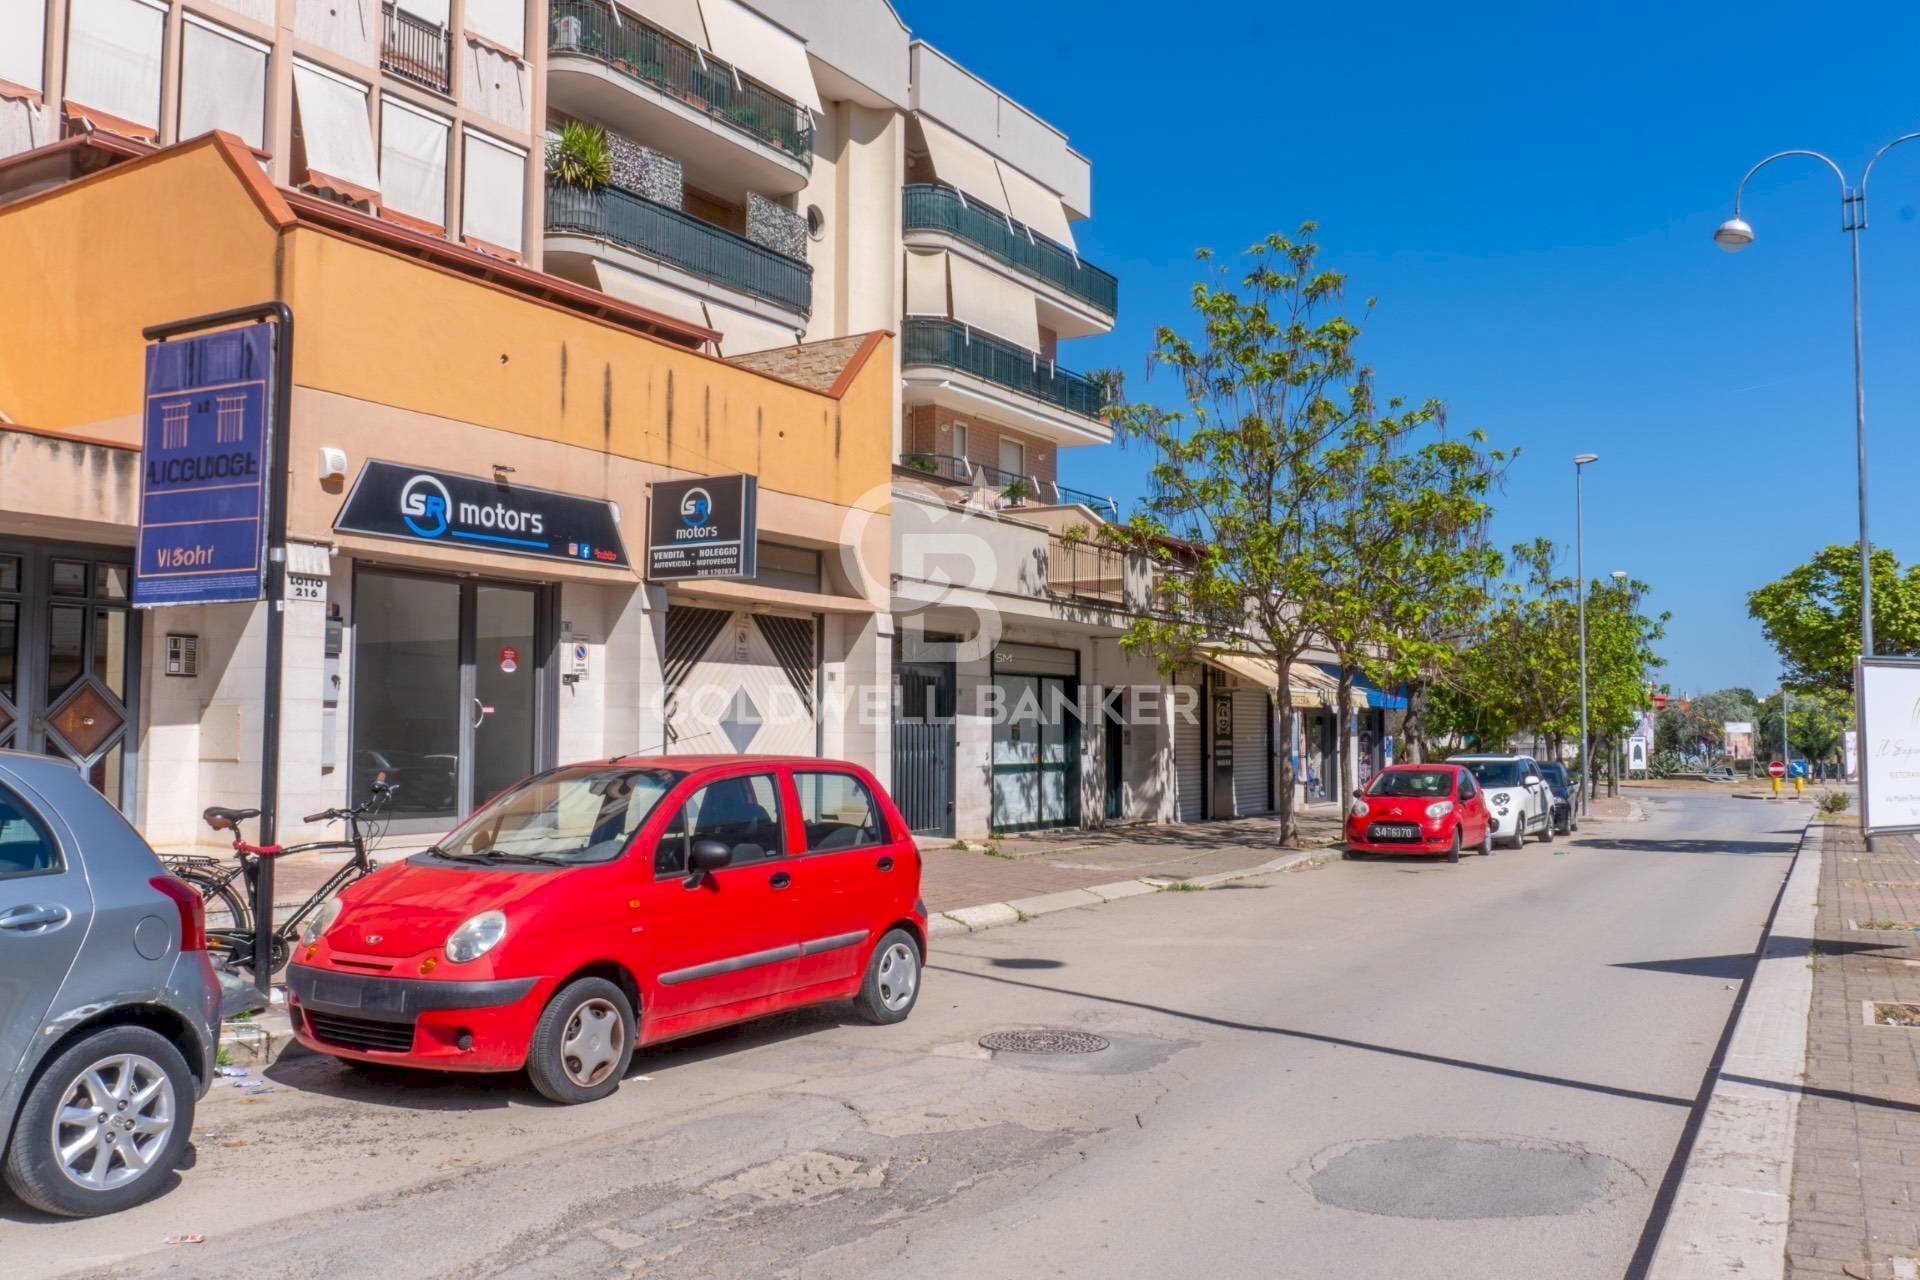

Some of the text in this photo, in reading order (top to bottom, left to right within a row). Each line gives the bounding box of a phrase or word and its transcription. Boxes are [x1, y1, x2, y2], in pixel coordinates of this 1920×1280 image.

[459, 501, 544, 534] motors
[676, 525, 718, 540] motors
[653, 550, 685, 560] VENDITA
[699, 547, 738, 557] NOLEGGIO
[653, 560, 691, 569] AUTOVEICOLI
[696, 557, 737, 566] MOTOVEICOLI
[290, 576, 323, 588] LOTTO
[295, 587, 318, 598] 216
